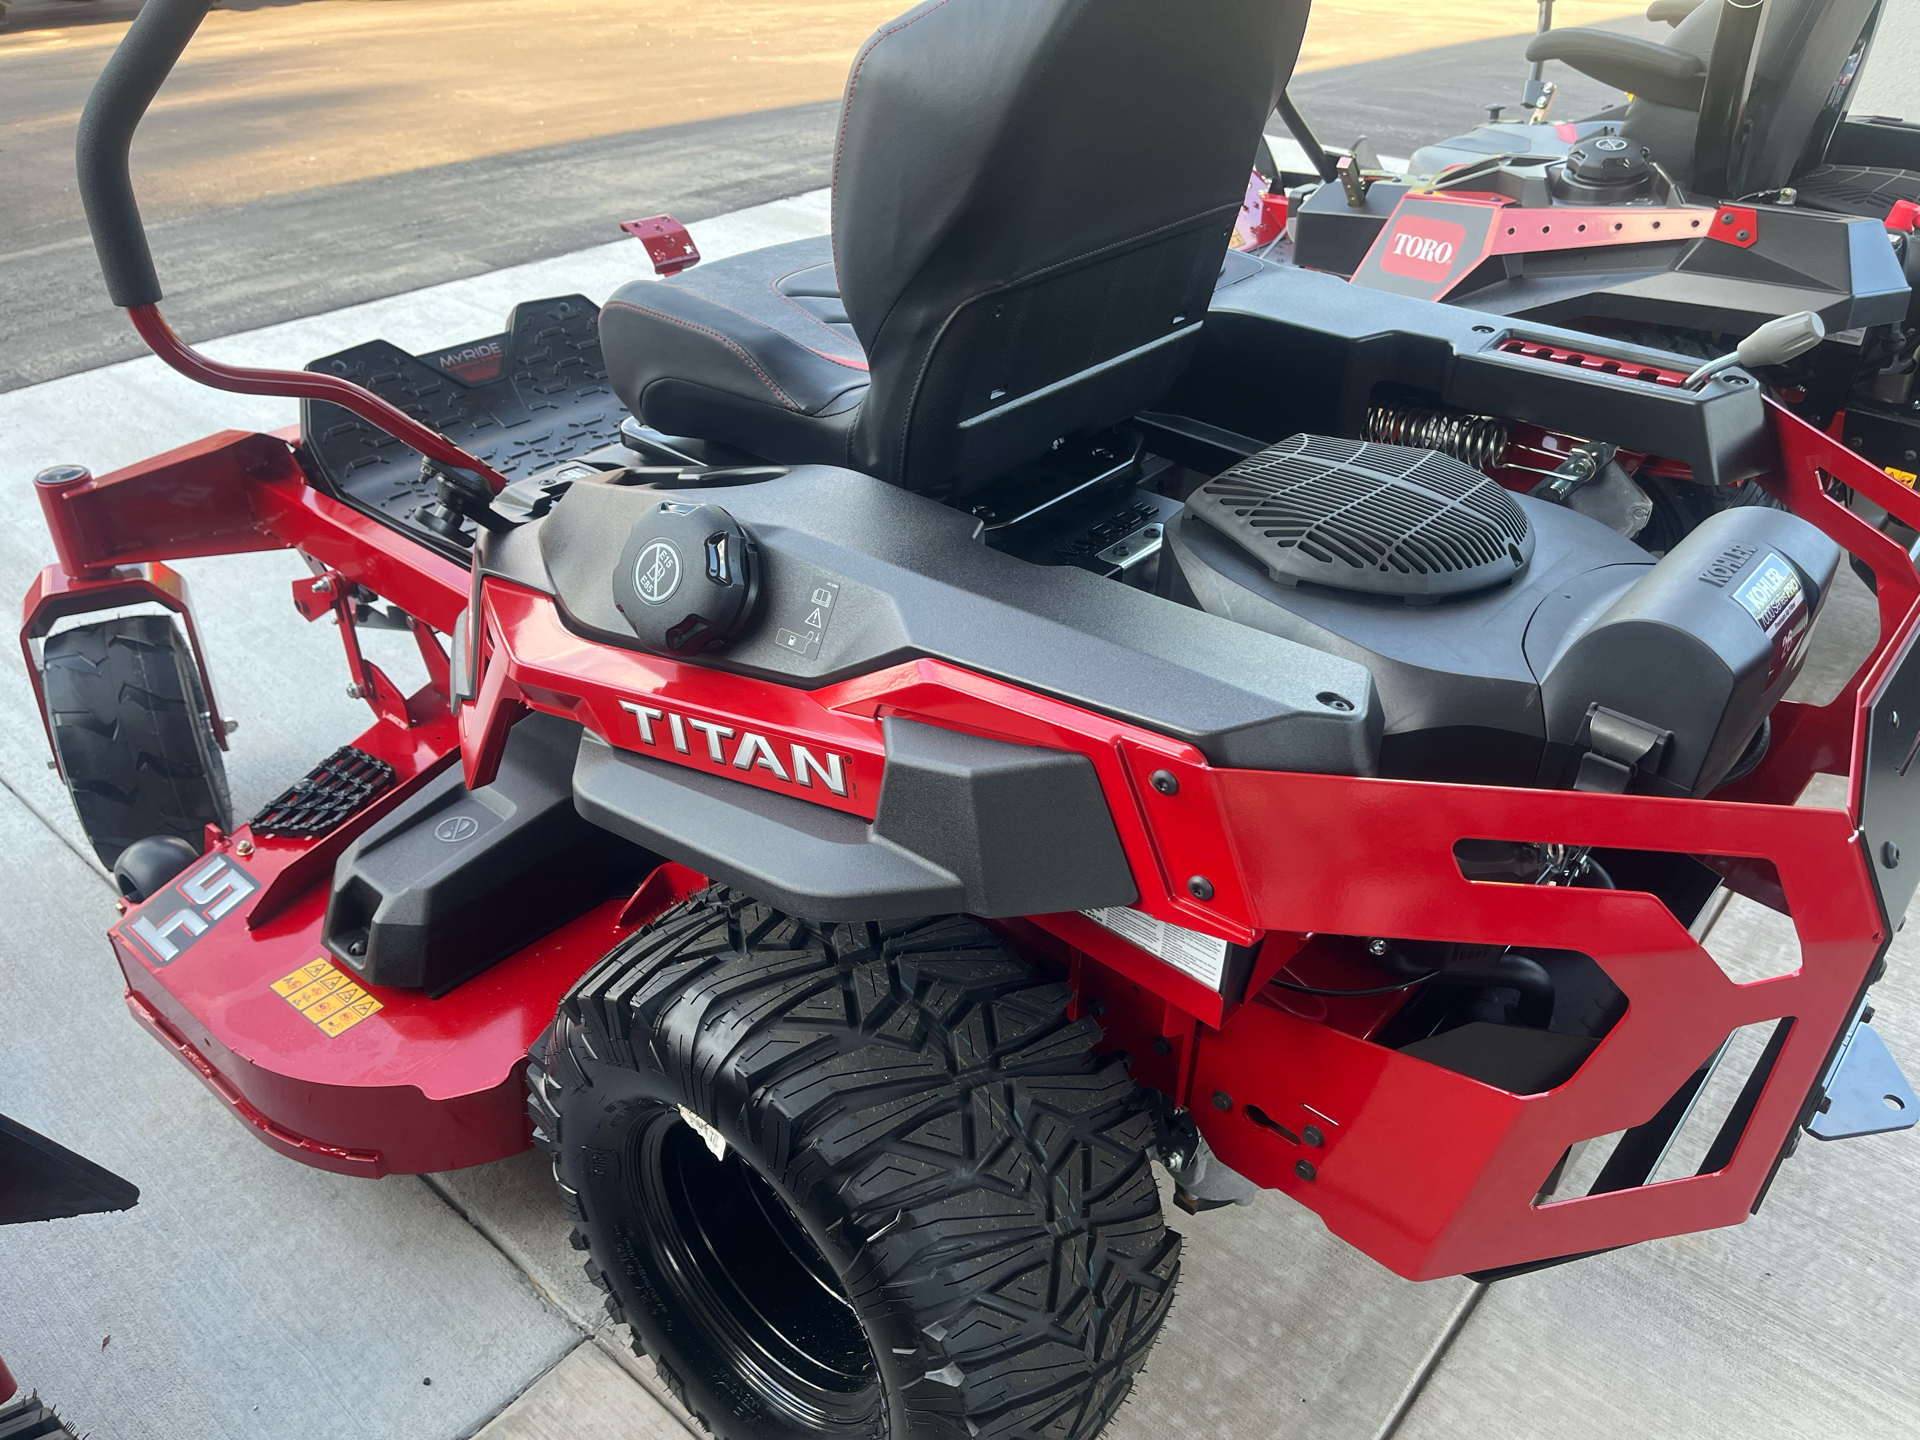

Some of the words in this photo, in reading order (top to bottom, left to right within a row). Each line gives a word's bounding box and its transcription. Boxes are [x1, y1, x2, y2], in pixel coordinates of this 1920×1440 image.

[1393, 233, 1452, 264] TORO
[660, 550, 673, 568] E15
[1699, 545, 1758, 588] KOHLER
[640, 575, 653, 592] E85
[1746, 567, 1784, 607] KOHLER
[618, 700, 848, 798] TITAN
[126, 856, 255, 962] 54
